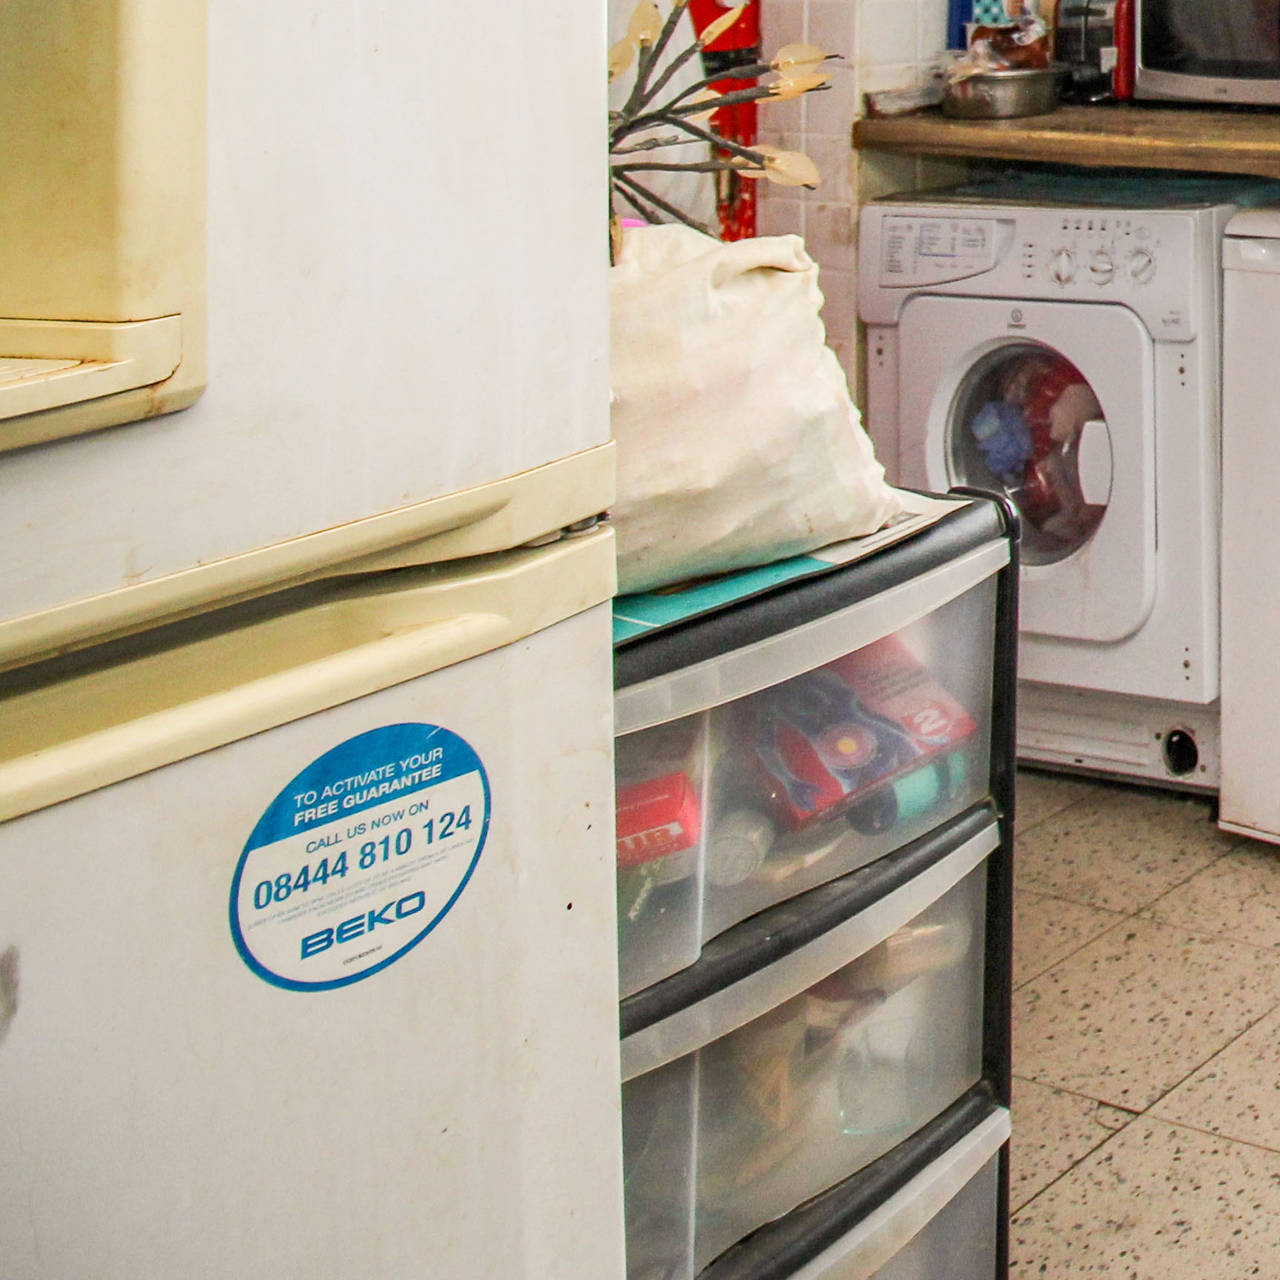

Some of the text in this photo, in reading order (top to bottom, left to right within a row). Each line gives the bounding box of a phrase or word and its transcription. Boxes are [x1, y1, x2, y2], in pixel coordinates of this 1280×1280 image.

[293, 746, 444, 809] TO ACTIVATE YOUR
[293, 763, 443, 827] FREE GUARANTEE
[253, 850, 349, 911] 08444
[358, 827, 413, 870] 810
[422, 804, 472, 846] 124
[305, 799, 430, 854] CALL US NOW ON
[300, 890, 426, 961] BEKO
